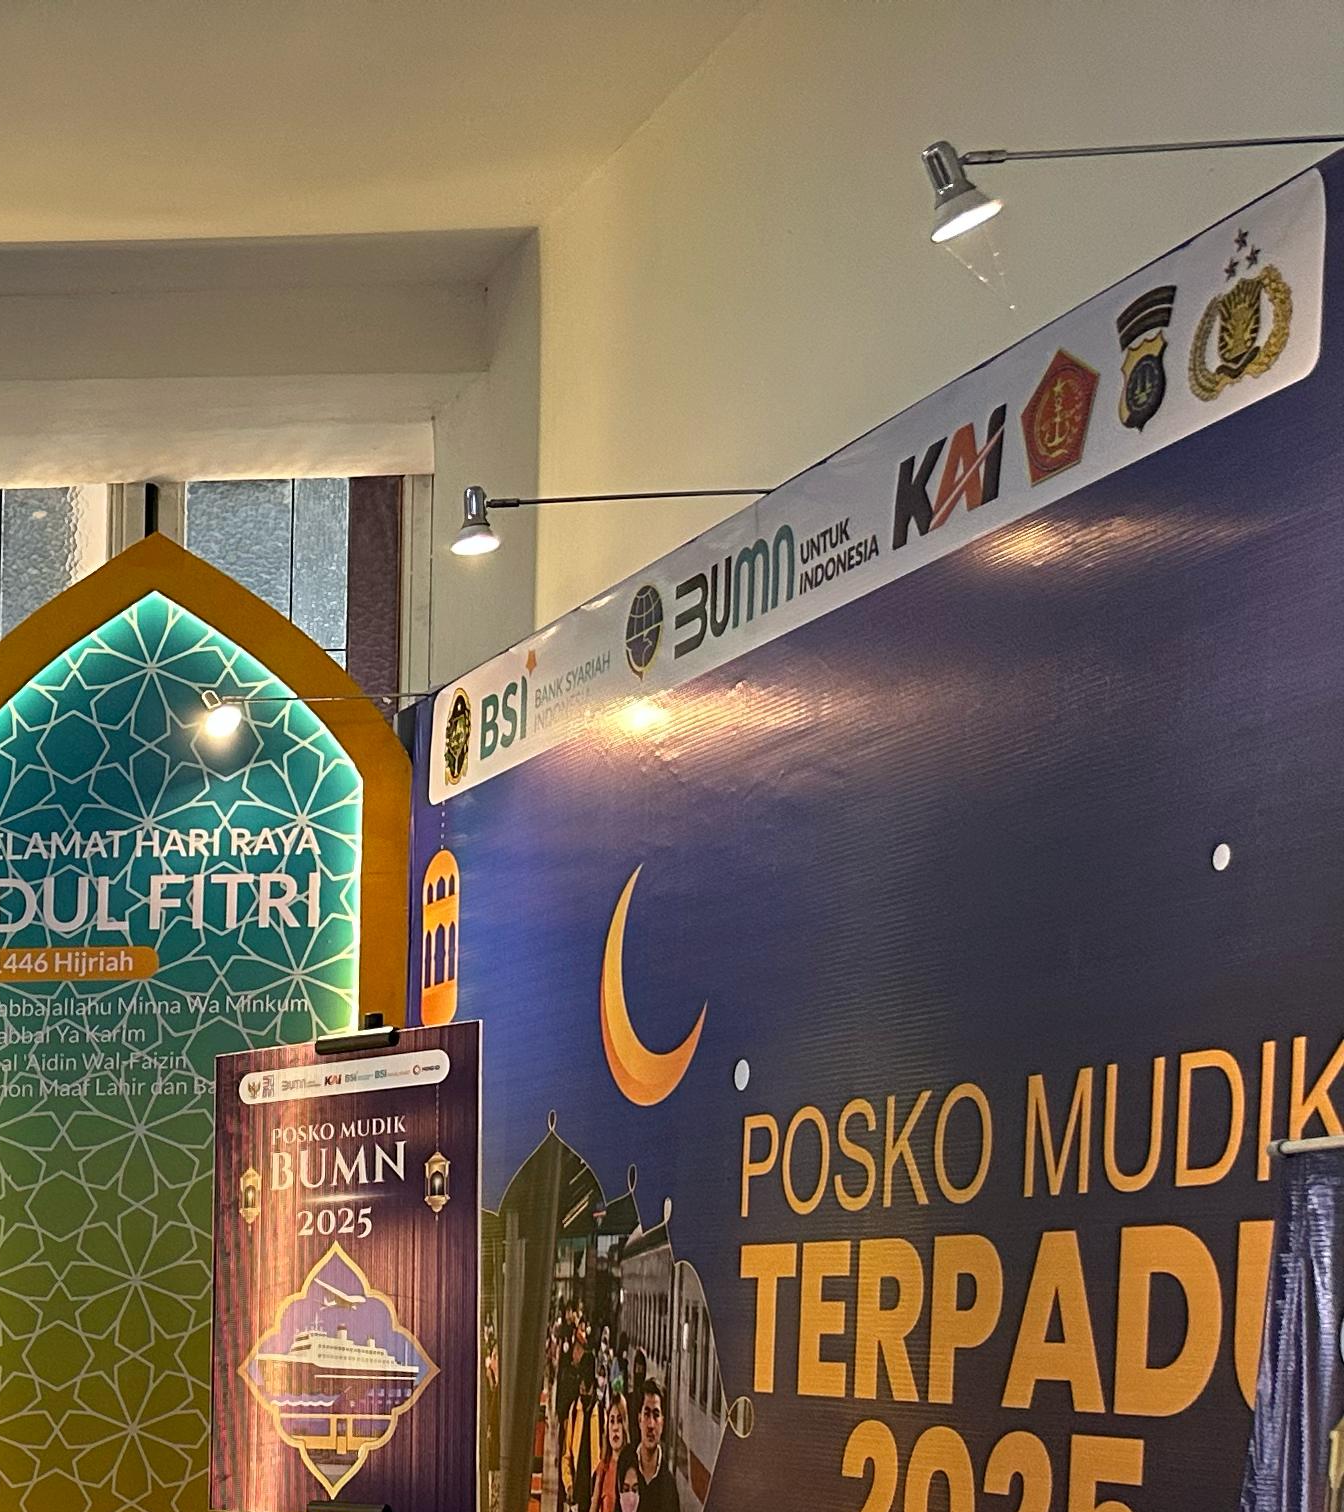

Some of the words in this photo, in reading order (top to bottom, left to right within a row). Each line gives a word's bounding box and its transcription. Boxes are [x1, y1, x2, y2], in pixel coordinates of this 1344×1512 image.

[892, 403, 1007, 550] KAI
[799, 518, 850, 564] UNTUK
[798, 534, 879, 596] INDONESIA
[534, 675, 564, 709] BANK
[565, 650, 611, 693] SYARIAH
[479, 674, 528, 762] BSI
[136, 829, 221, 857] HARI
[230, 827, 322, 855] RAYA
[149, 871, 321, 930] FITRI
[54, 951, 133, 976] Hijriah
[117, 996, 181, 1016] Minna
[187, 995, 220, 1015] Wa
[226, 993, 308, 1013] Minkum
[55, 1026, 80, 1044] Ya
[85, 1023, 146, 1043] Karim
[23, 1052, 77, 1073] 'Aidin
[82, 1051, 188, 1072] Wal-Faizin
[39, 1078, 91, 1098] Maaf
[95, 1077, 146, 1096] Lahir
[151, 1075, 188, 1095] dan
[193, 1075, 216, 1094] Ba
[272, 1122, 334, 1144] POSKO
[340, 1115, 407, 1138] MUDIK
[740, 1082, 993, 1218] POSKO
[1023, 1036, 1344, 1198] MUDIK
[272, 1141, 407, 1190] BUMN
[296, 1207, 373, 1238] 2025
